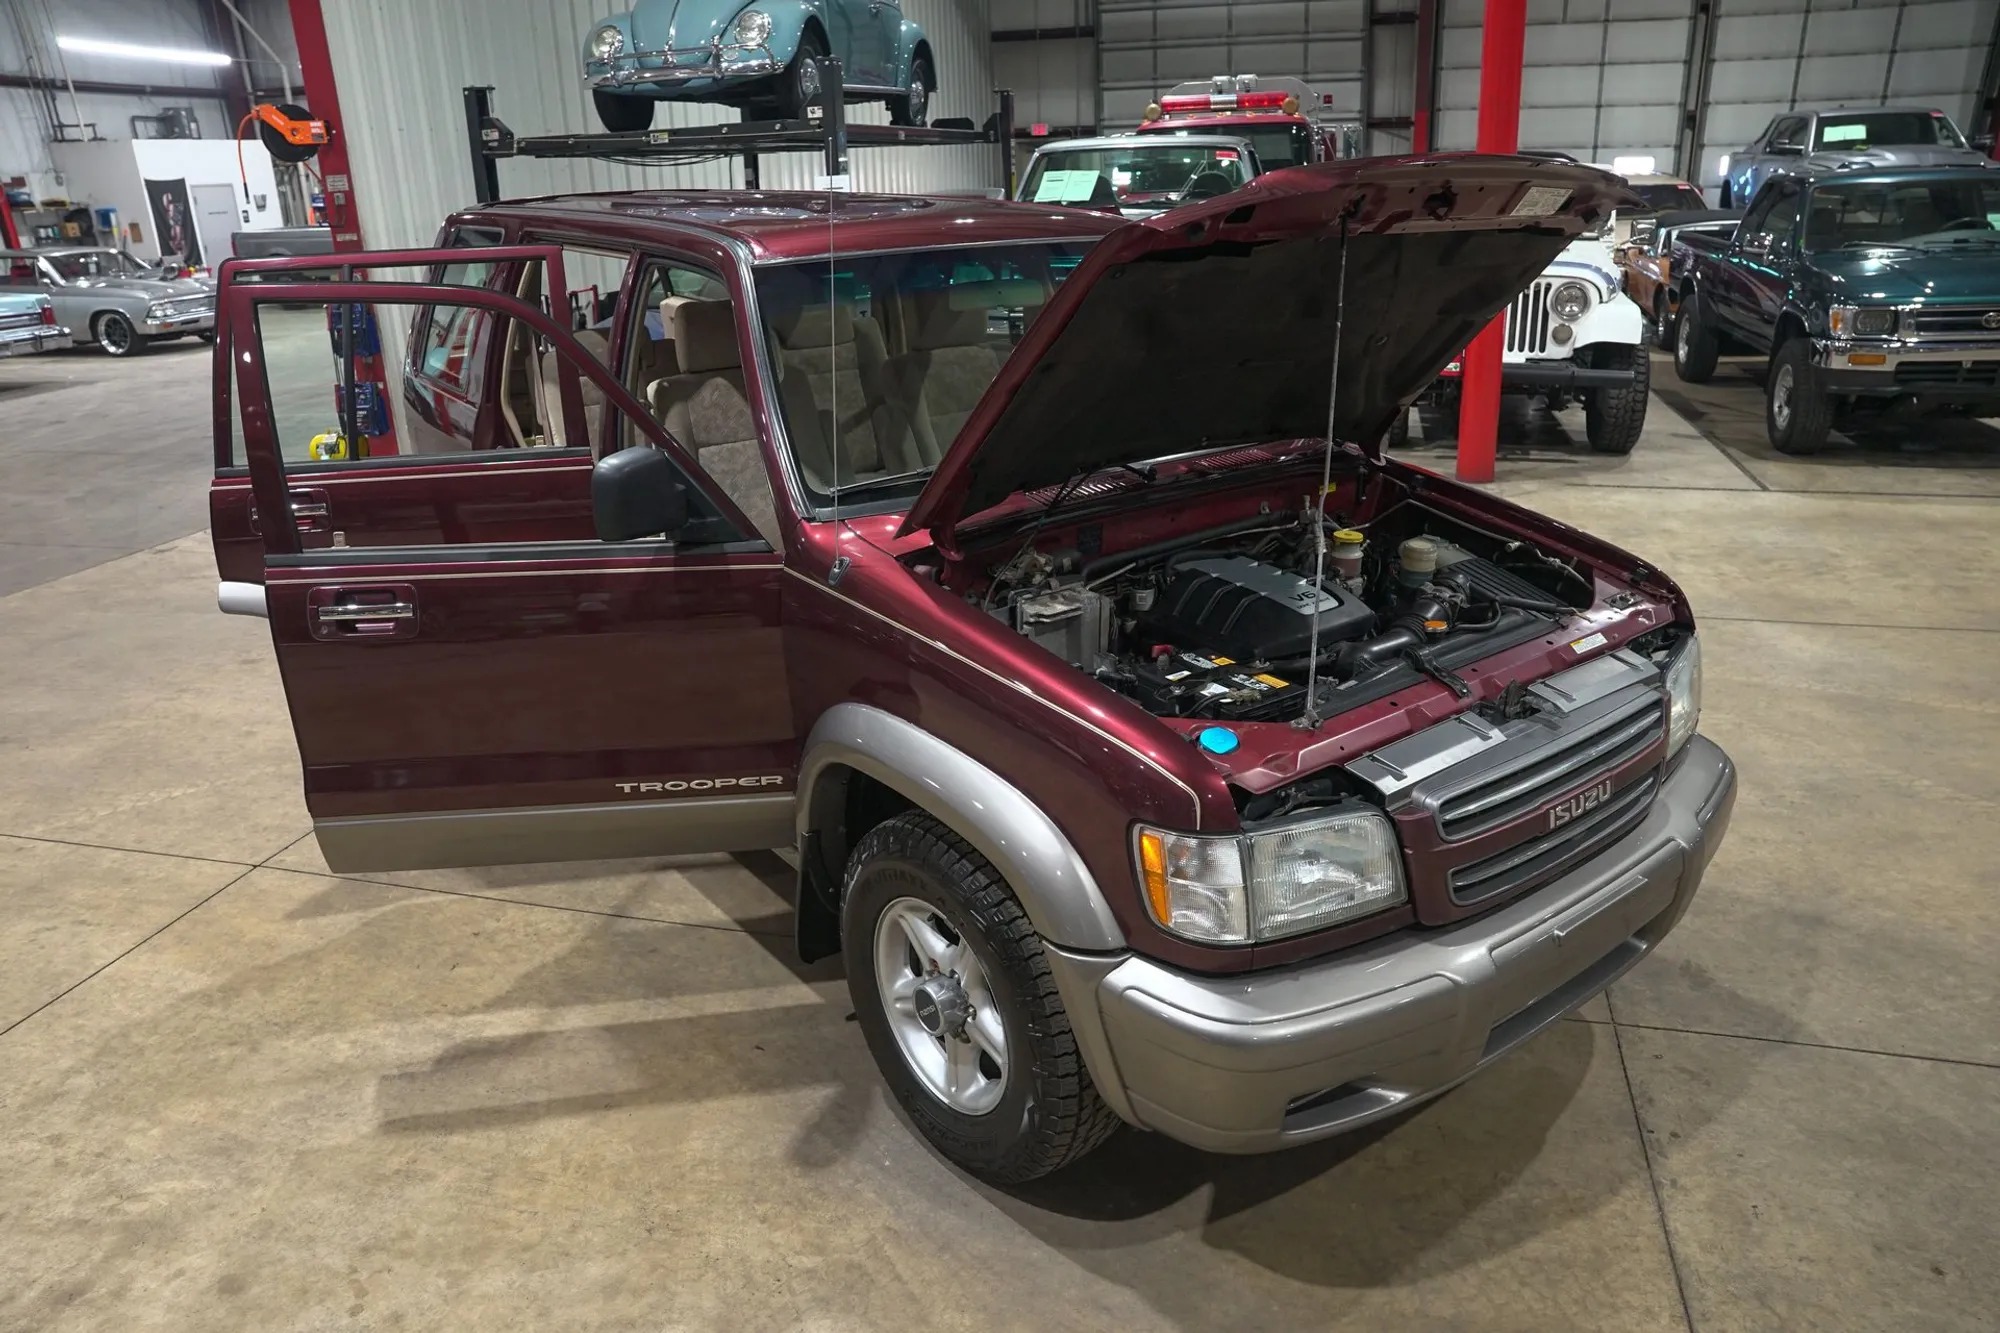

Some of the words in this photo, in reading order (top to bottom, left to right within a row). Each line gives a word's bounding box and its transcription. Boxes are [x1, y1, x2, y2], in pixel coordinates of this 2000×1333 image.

[1287, 590, 1316, 602] V6
[615, 775, 784, 793] TROOPER
[1549, 779, 1611, 830] ISUZU
